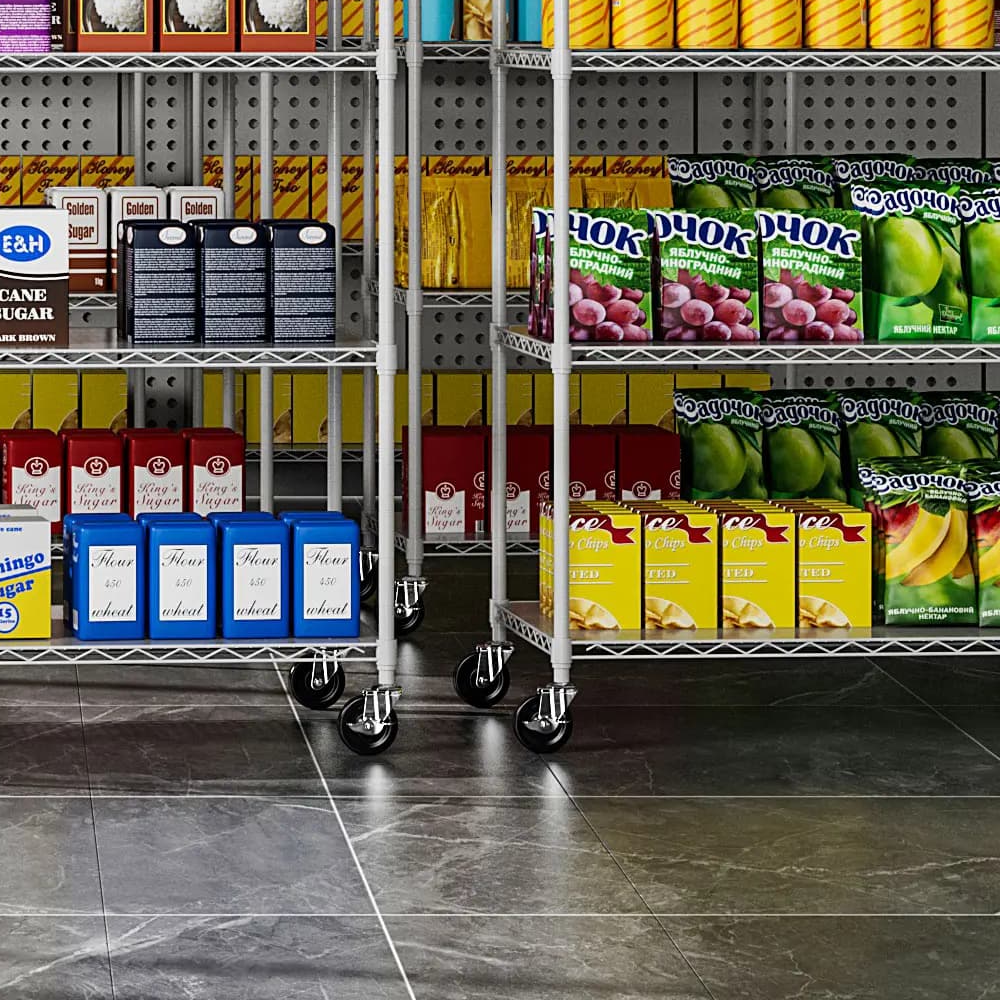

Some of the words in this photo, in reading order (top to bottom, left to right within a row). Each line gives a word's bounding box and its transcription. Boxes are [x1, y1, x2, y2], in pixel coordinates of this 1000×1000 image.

[67, 202, 94, 215] Golden
[127, 202, 153, 215] Golden
[185, 202, 212, 215] Golden
[69, 224, 94, 240] Sugar
[3, 235, 46, 256] E&H
[670, 247, 731, 264] ЯБЛУЧНО-
[772, 247, 834, 264] ЯБЛУЧНО-
[893, 325, 931, 334] ЯБЛУЧНИЙ
[933, 325, 958, 335] НЕКТАР
[18, 334, 56, 343] BROWN
[16, 483, 56, 498] King's
[75, 483, 115, 498] King's
[137, 483, 177, 498] King's
[198, 483, 237, 498] King's
[14, 496, 58, 510] Sugar
[73, 496, 117, 510] Sugar
[136, 496, 180, 510] Sugar
[195, 496, 239, 510] Sugar
[427, 505, 461, 518] King's
[577, 536, 609, 552] Chips
[654, 536, 685, 552] Chips
[732, 536, 763, 552] Chips
[809, 536, 840, 552] Chips
[91, 548, 135, 568] Flour
[162, 548, 205, 568] Flour
[236, 548, 279, 568] Flour
[305, 547, 349, 567] Flour
[92, 601, 133, 617] wheat
[162, 601, 203, 617] wheat
[236, 600, 278, 617] wheat
[306, 599, 348, 616] wheat
[918, 613, 948, 621] НЕКТАР
